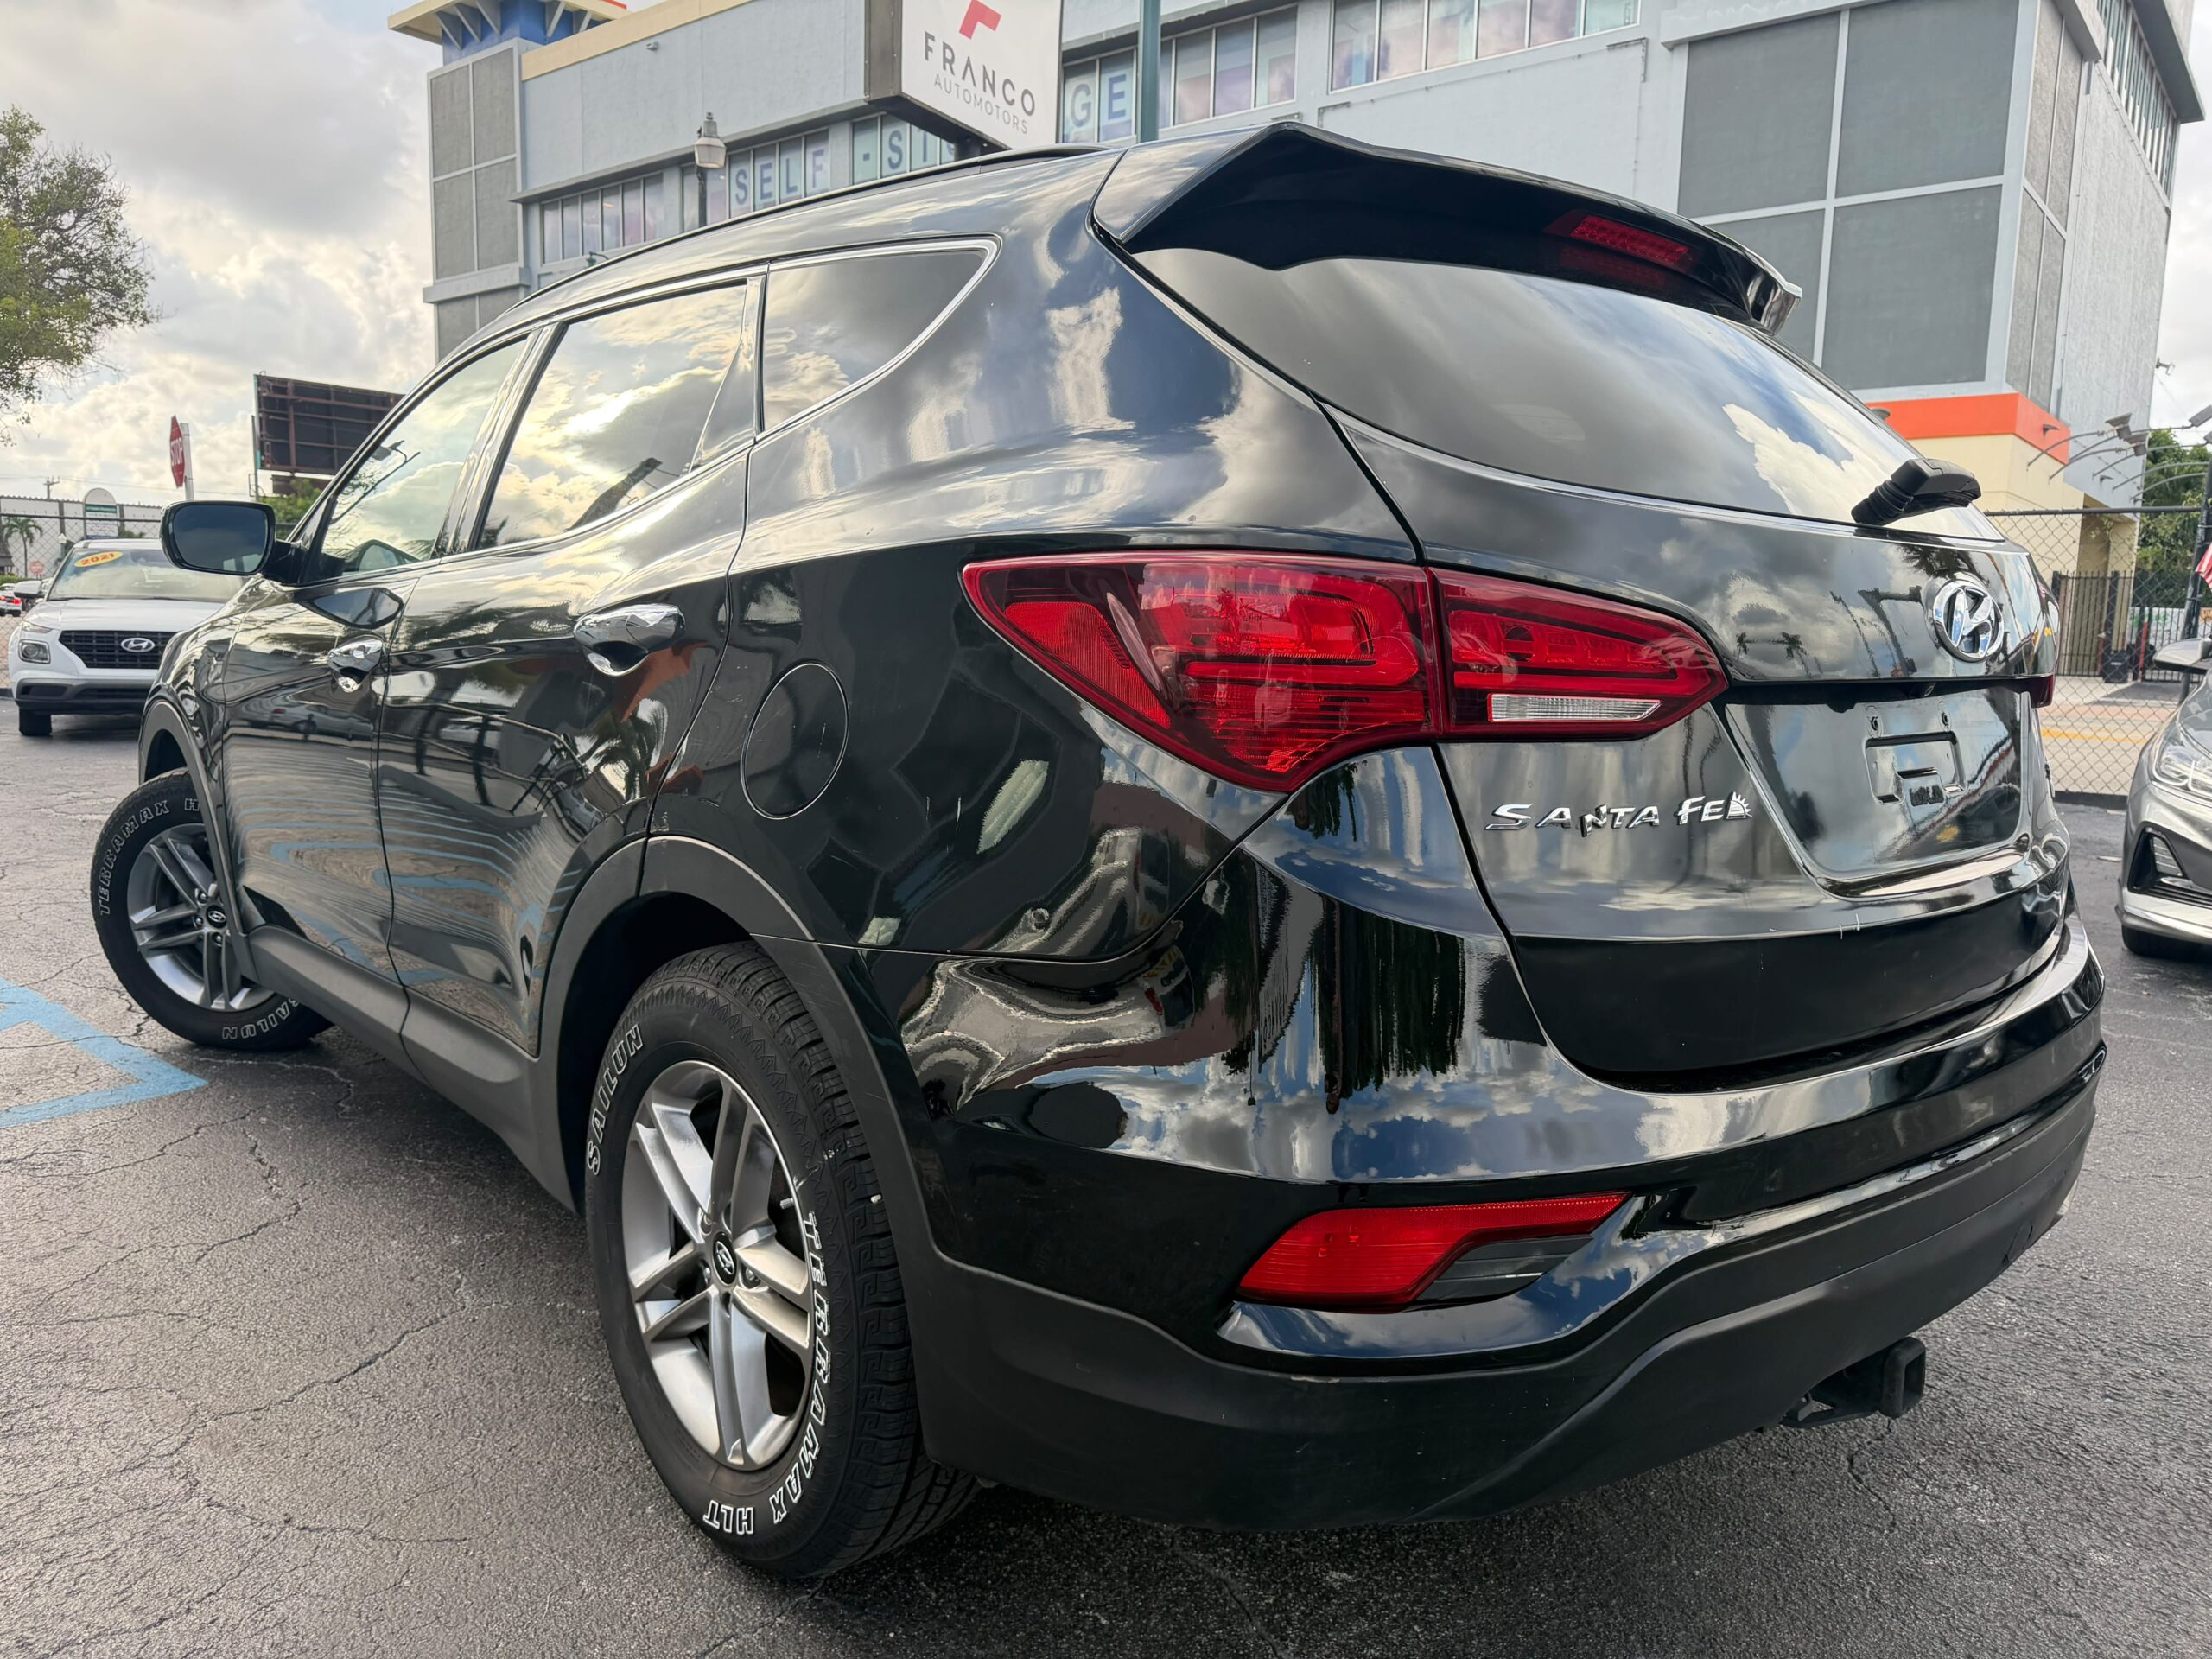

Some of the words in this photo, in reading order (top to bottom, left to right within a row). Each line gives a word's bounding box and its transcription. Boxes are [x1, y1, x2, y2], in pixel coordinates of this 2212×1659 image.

[925, 31, 1035, 116] FRANCO
[934, 73, 1028, 135] AUTOMOTORS
[734, 149, 825, 206] SELF
[170, 437, 183, 467] STOP
[82, 552, 115, 566] 2021
[1484, 804, 1661, 837] SANTA
[1676, 796, 1726, 826] FE
[98, 799, 170, 916] TERRAMAX
[587, 1024, 644, 1176] SAILUN
[768, 1211, 831, 1525] TERRAMAX
[702, 1499, 754, 1535] HLT
